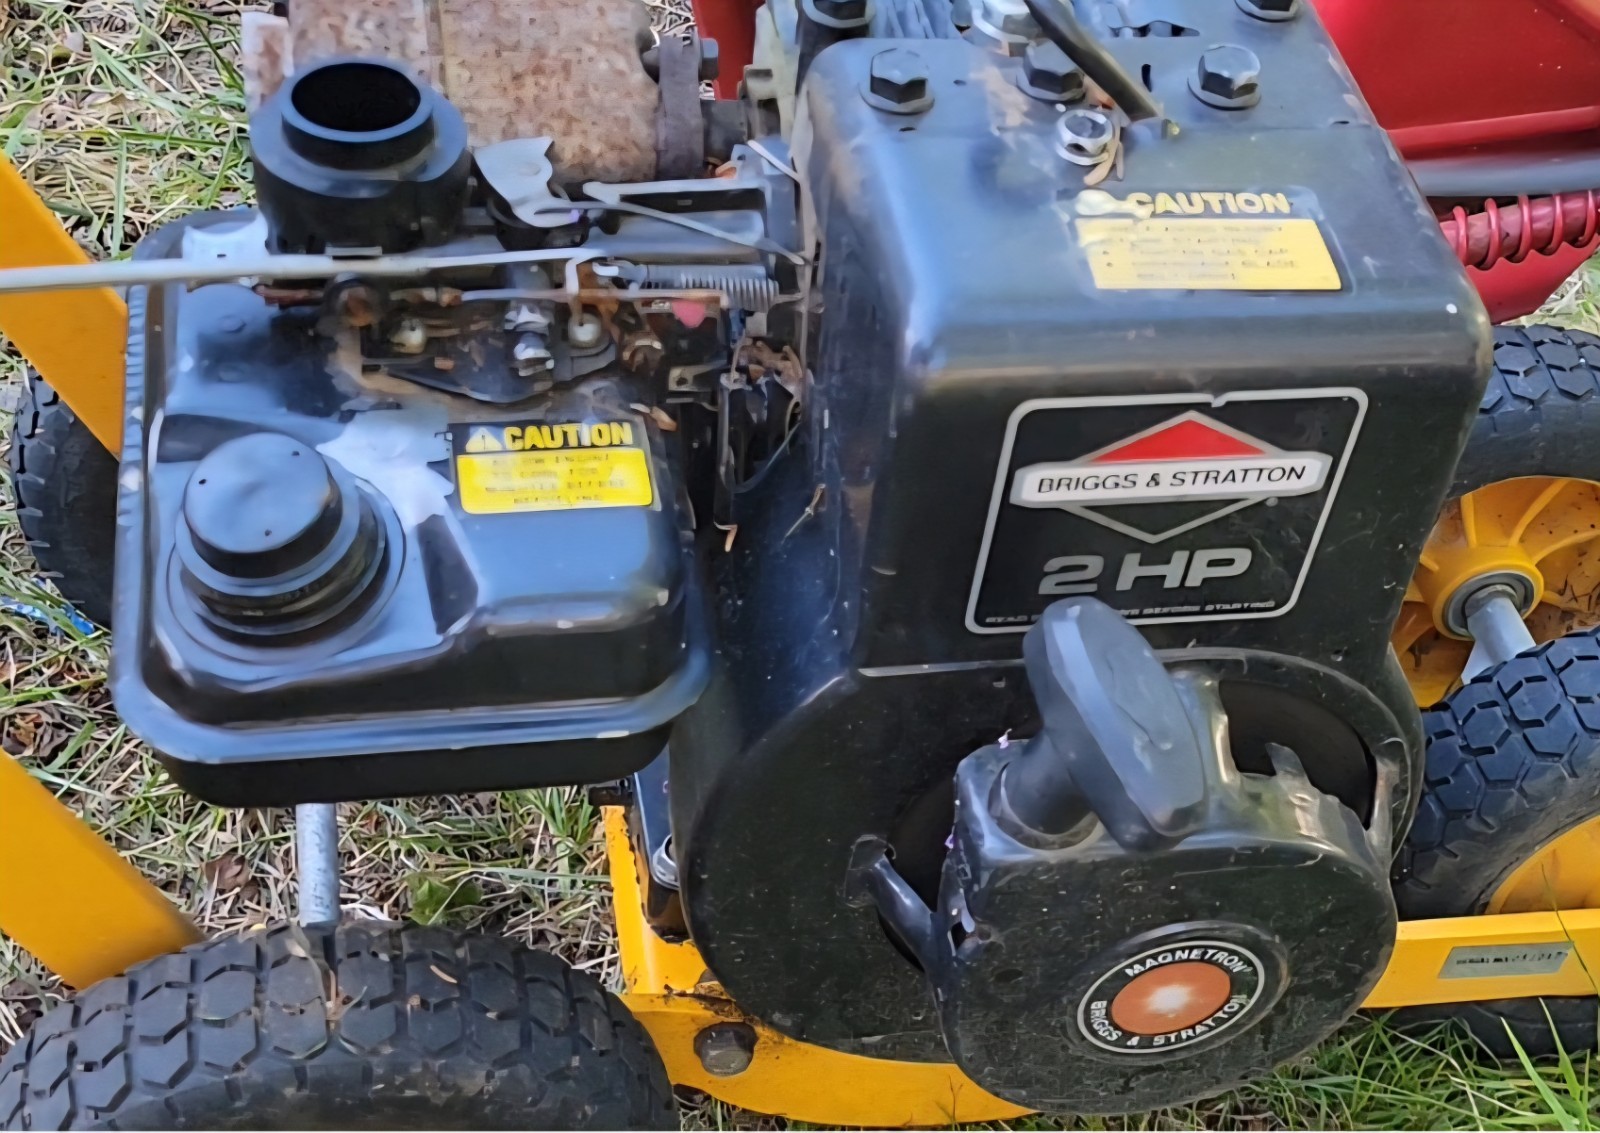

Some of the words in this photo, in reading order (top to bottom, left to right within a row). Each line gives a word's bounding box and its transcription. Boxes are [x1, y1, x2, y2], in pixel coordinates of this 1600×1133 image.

[1126, 191, 1291, 215] CAUTION
[504, 421, 634, 450] CAUTION
[1037, 473, 1139, 493] BRIGGS
[1146, 472, 1161, 488] &
[1169, 465, 1306, 488] STRATTON
[1038, 555, 1104, 595] 2
[1115, 547, 1252, 591] HP
[1124, 948, 1248, 977] MAGNETRON
[1090, 1000, 1123, 1042] BRIGGS
[1152, 994, 1249, 1046] STRATTON
